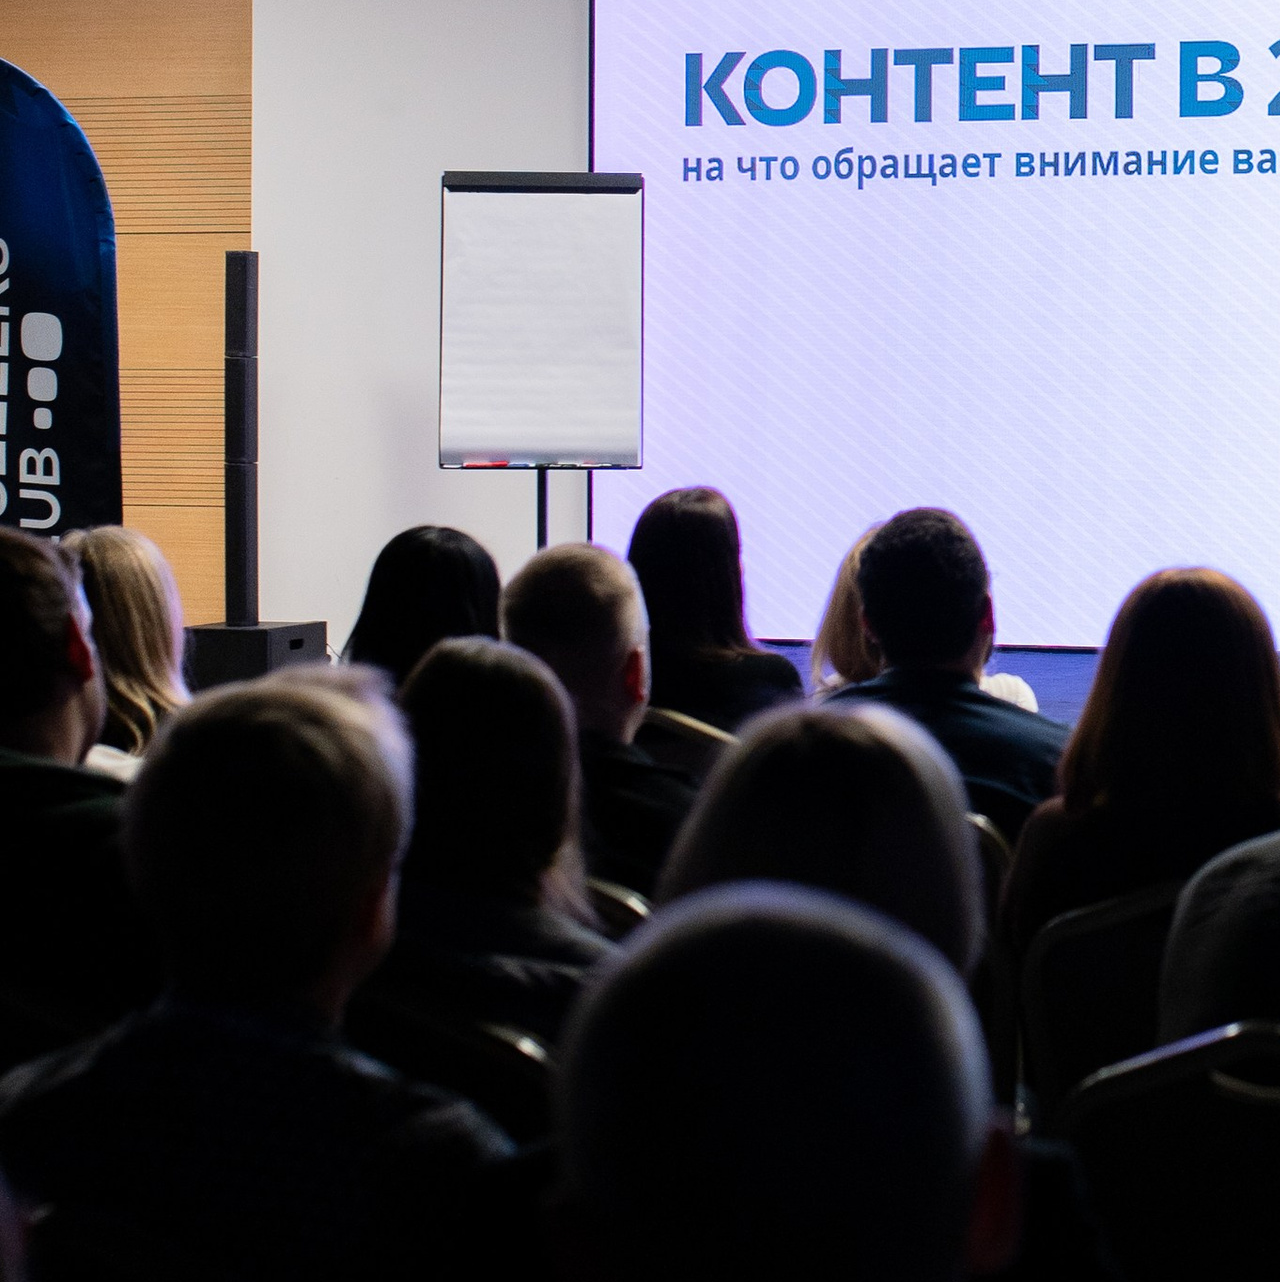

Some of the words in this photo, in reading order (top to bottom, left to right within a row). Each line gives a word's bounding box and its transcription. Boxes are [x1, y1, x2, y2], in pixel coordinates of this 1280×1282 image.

[683, 42, 1157, 128] КОНТЕНТ
[1178, 39, 1246, 119] В
[682, 156, 725, 183] на
[737, 155, 800, 182] что
[811, 146, 1003, 191] обращает
[1014, 149, 1220, 179] внимание
